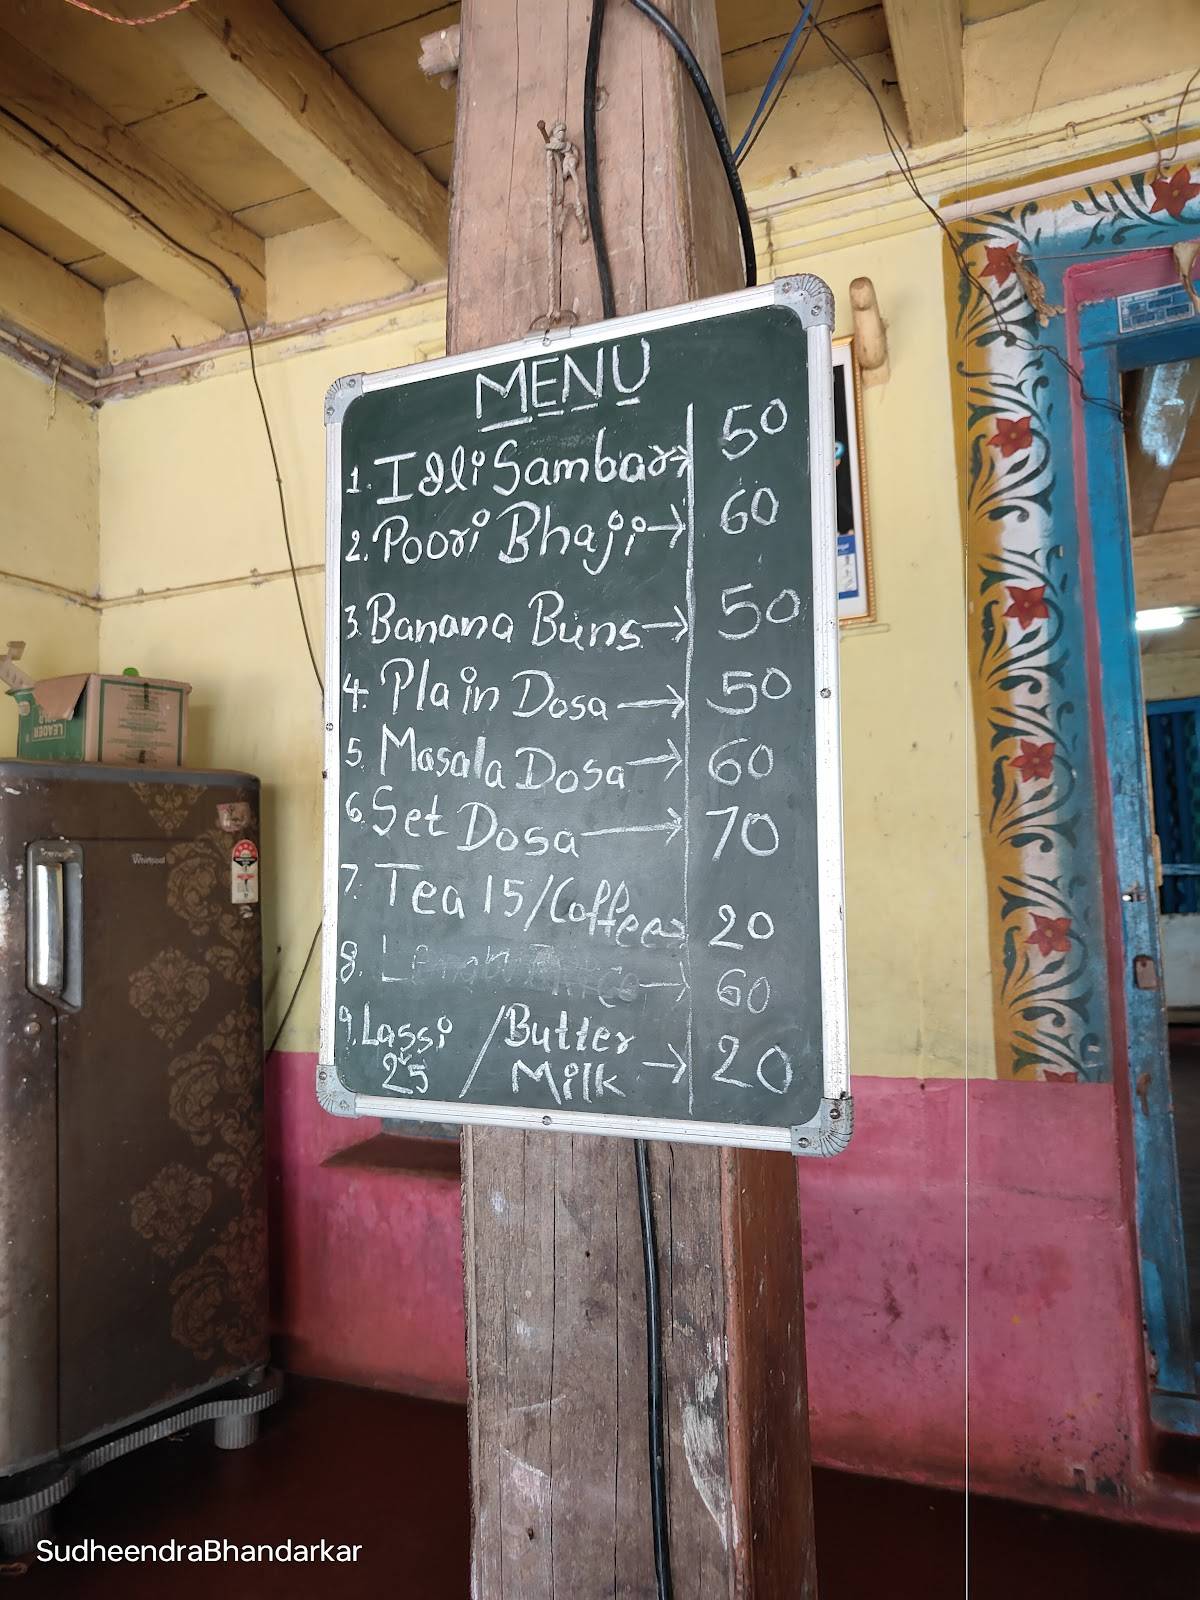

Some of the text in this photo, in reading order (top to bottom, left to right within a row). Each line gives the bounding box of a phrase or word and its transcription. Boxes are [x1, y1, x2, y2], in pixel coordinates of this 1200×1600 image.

[475, 338, 651, 420] MENU
[373, 445, 486, 505] Idli
[492, 426, 676, 497] Sambar
[721, 398, 788, 461] 50
[345, 487, 780, 576] 2. Poori Bhaji 60
[366, 592, 514, 645] Banana
[718, 583, 801, 641] 50
[380, 657, 500, 716] Plain
[512, 669, 609, 721] Dosa
[706, 667, 793, 716] 50
[379, 724, 507, 789] Masala
[515, 747, 626, 794] Dosa
[708, 738, 774, 787] 60
[372, 784, 450, 838] Set
[456, 801, 580, 859] Dosa
[706, 805, 780, 862] 70
[374, 862, 466, 920] Tea
[708, 904, 775, 951] 20
[716, 968, 771, 1014] 60
[361, 1001, 453, 1055] Lassi
[381, 1034, 794, 1106] 25 Milk 20
